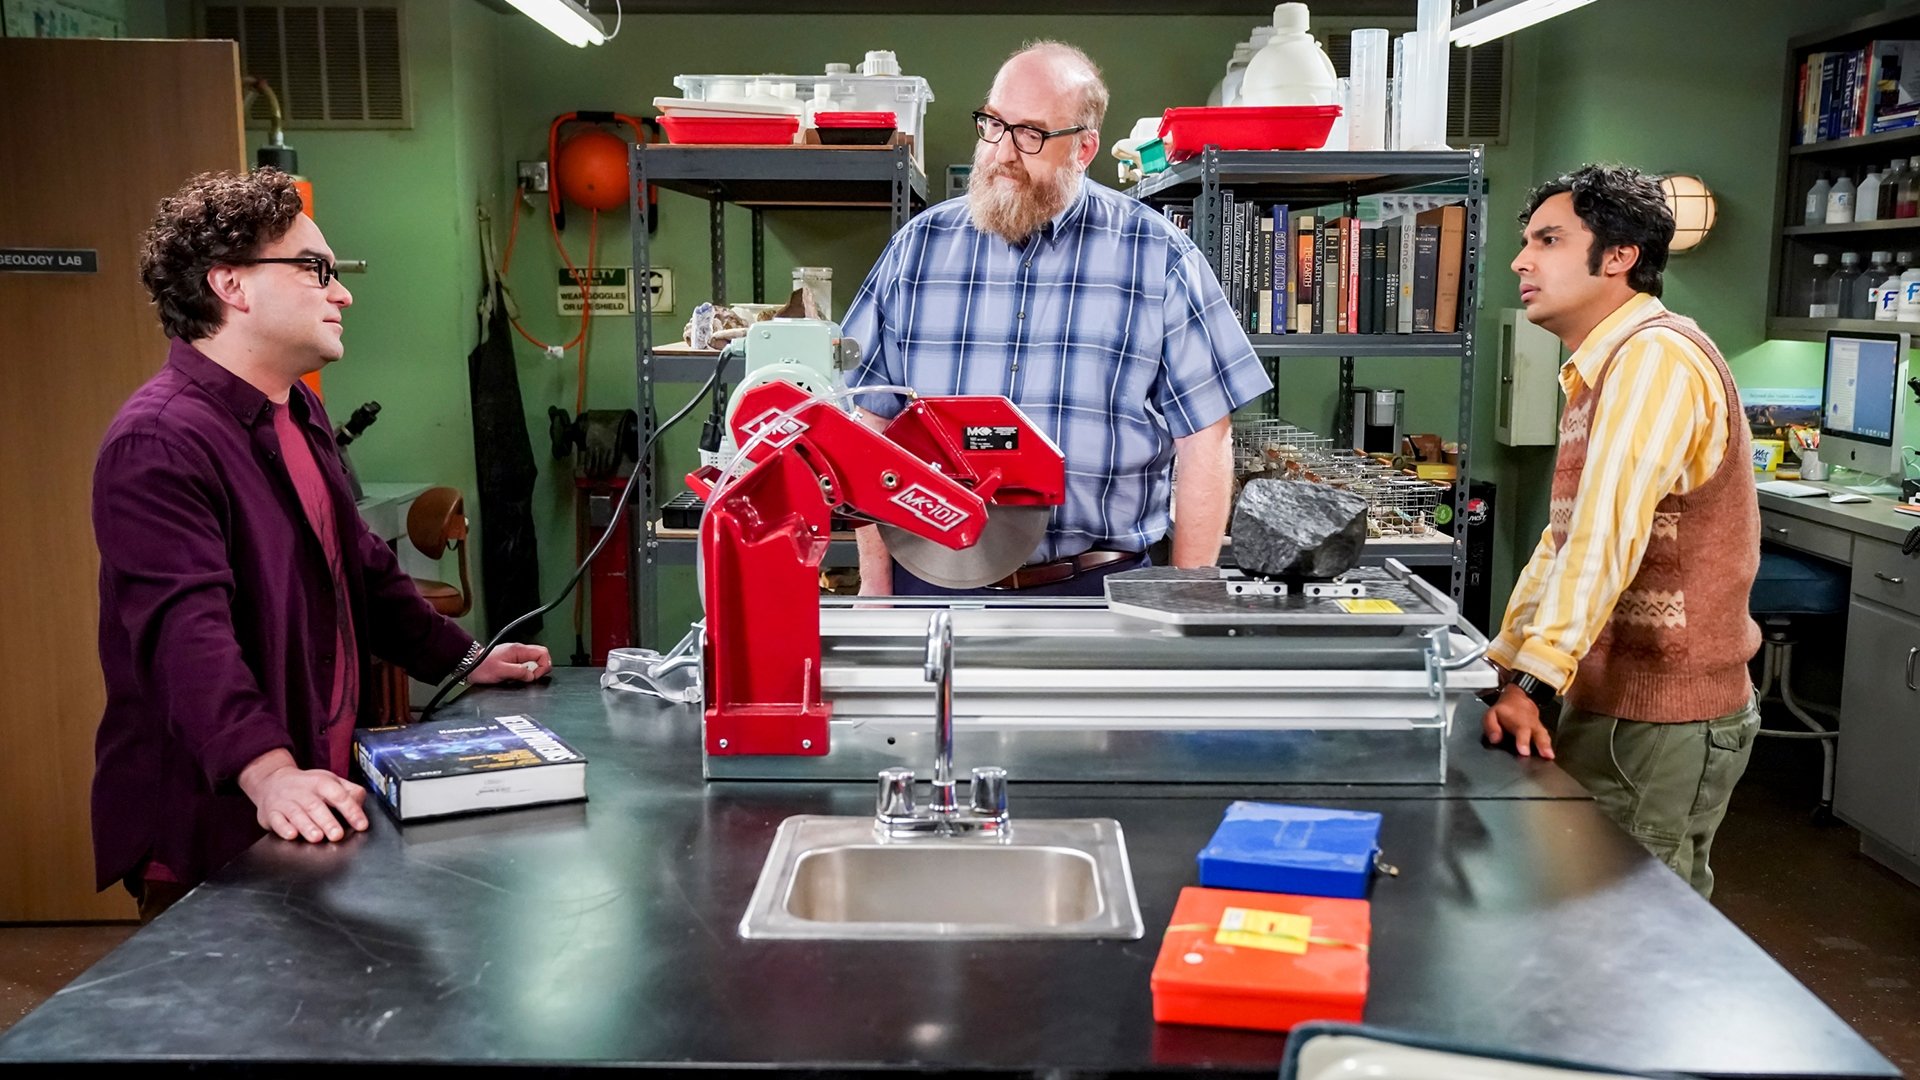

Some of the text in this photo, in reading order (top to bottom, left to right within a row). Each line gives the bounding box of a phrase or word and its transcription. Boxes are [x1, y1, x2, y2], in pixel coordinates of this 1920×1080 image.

[1844, 57, 1857, 108] Fisher
[1235, 212, 1245, 247] Minerals
[1274, 231, 1286, 251] GEM
[1315, 223, 1323, 254] PLANET
[1235, 248, 1243, 261] and
[1402, 225, 1412, 270] Science
[58, 256, 82, 266] LAB
[1233, 262, 1243, 283] Man
[1274, 252, 1286, 290] CUTTING
[1303, 247, 1312, 288] THE EARTH
[1753, 448, 1770, 458] Wet
[438, 726, 487, 734] Handbook
